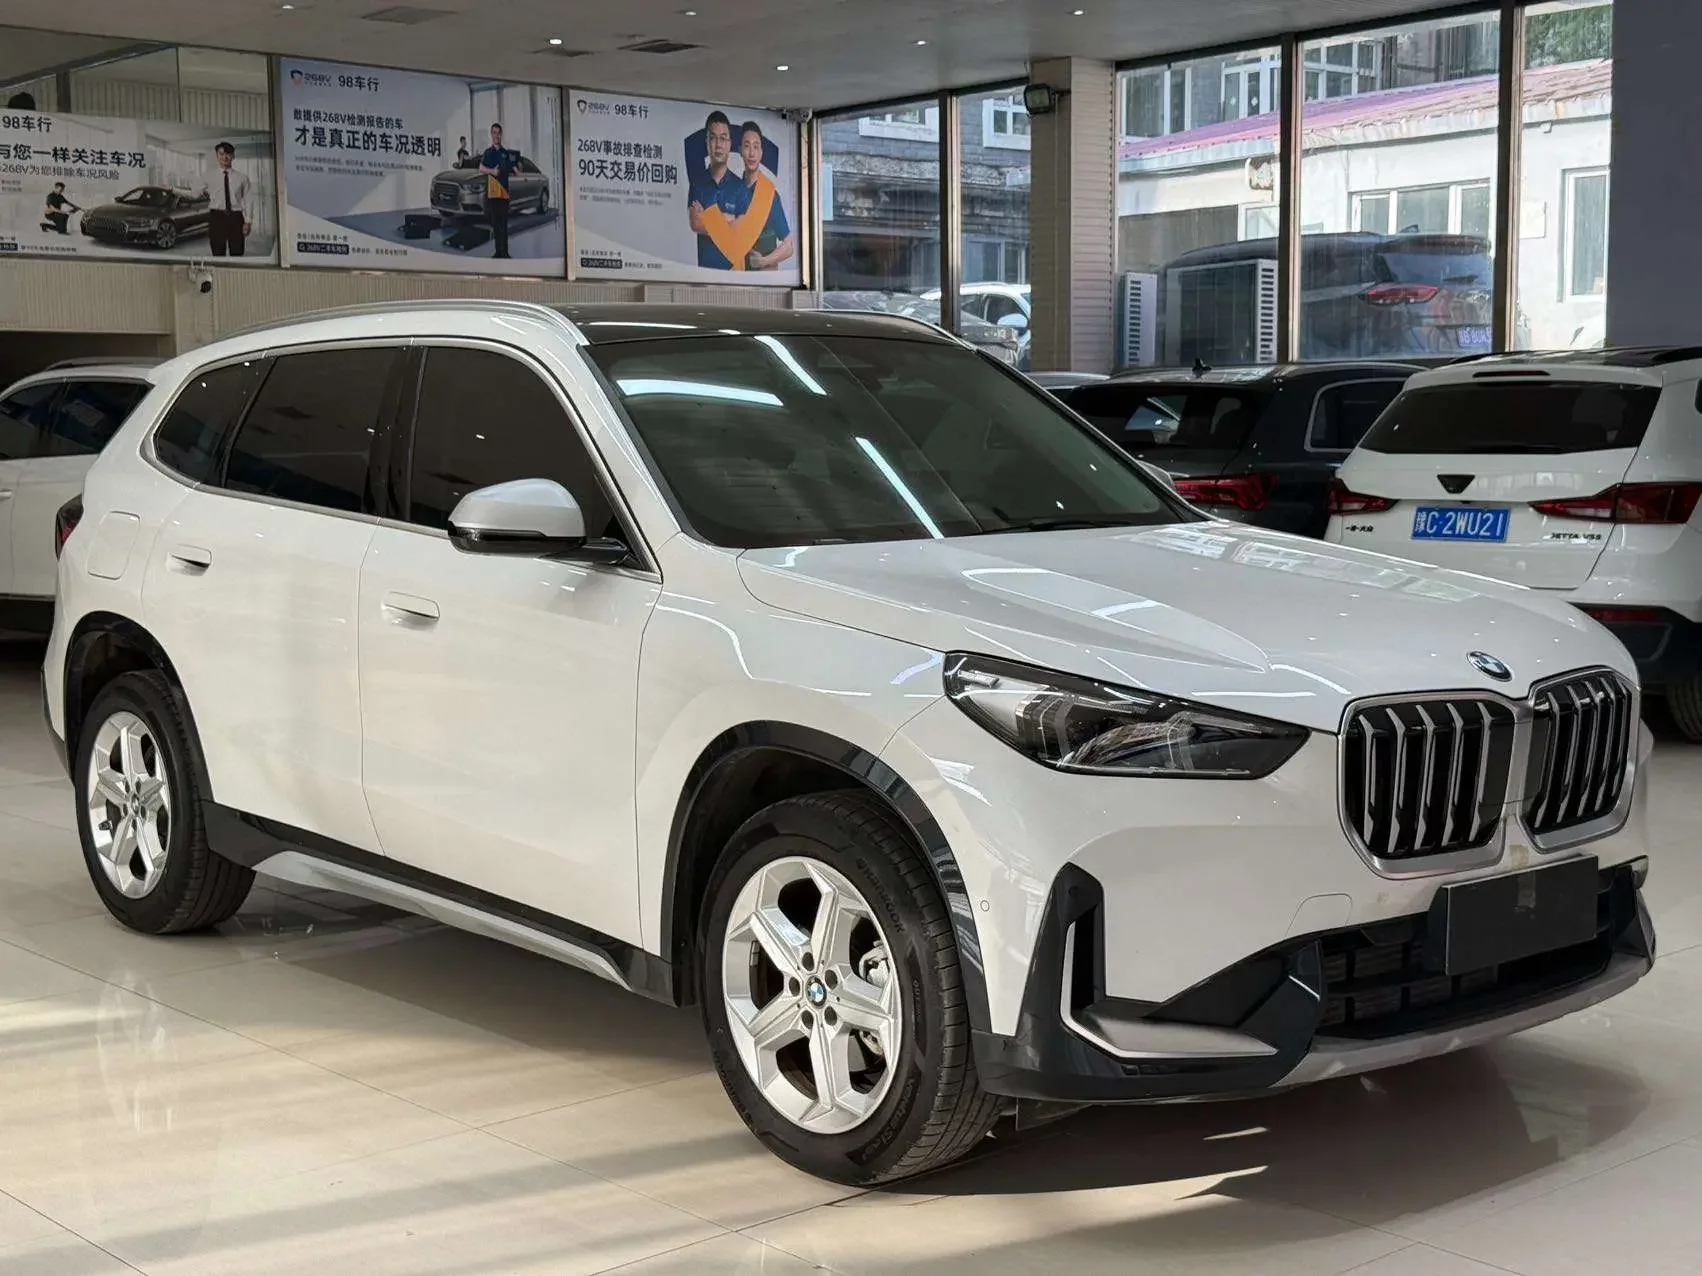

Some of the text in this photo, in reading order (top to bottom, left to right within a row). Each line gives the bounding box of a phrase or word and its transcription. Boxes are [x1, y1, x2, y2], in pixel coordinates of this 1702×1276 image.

[338, 75, 379, 92] 98车行
[614, 104, 649, 119] 98车行
[2, 115, 52, 133] 98车行
[294, 125, 442, 157] 才是真正的车况透明
[578, 139, 663, 159] 268V事故排查检测
[0, 143, 146, 168] 与您一样关注车况
[578, 158, 678, 185] 90天交易价回购
